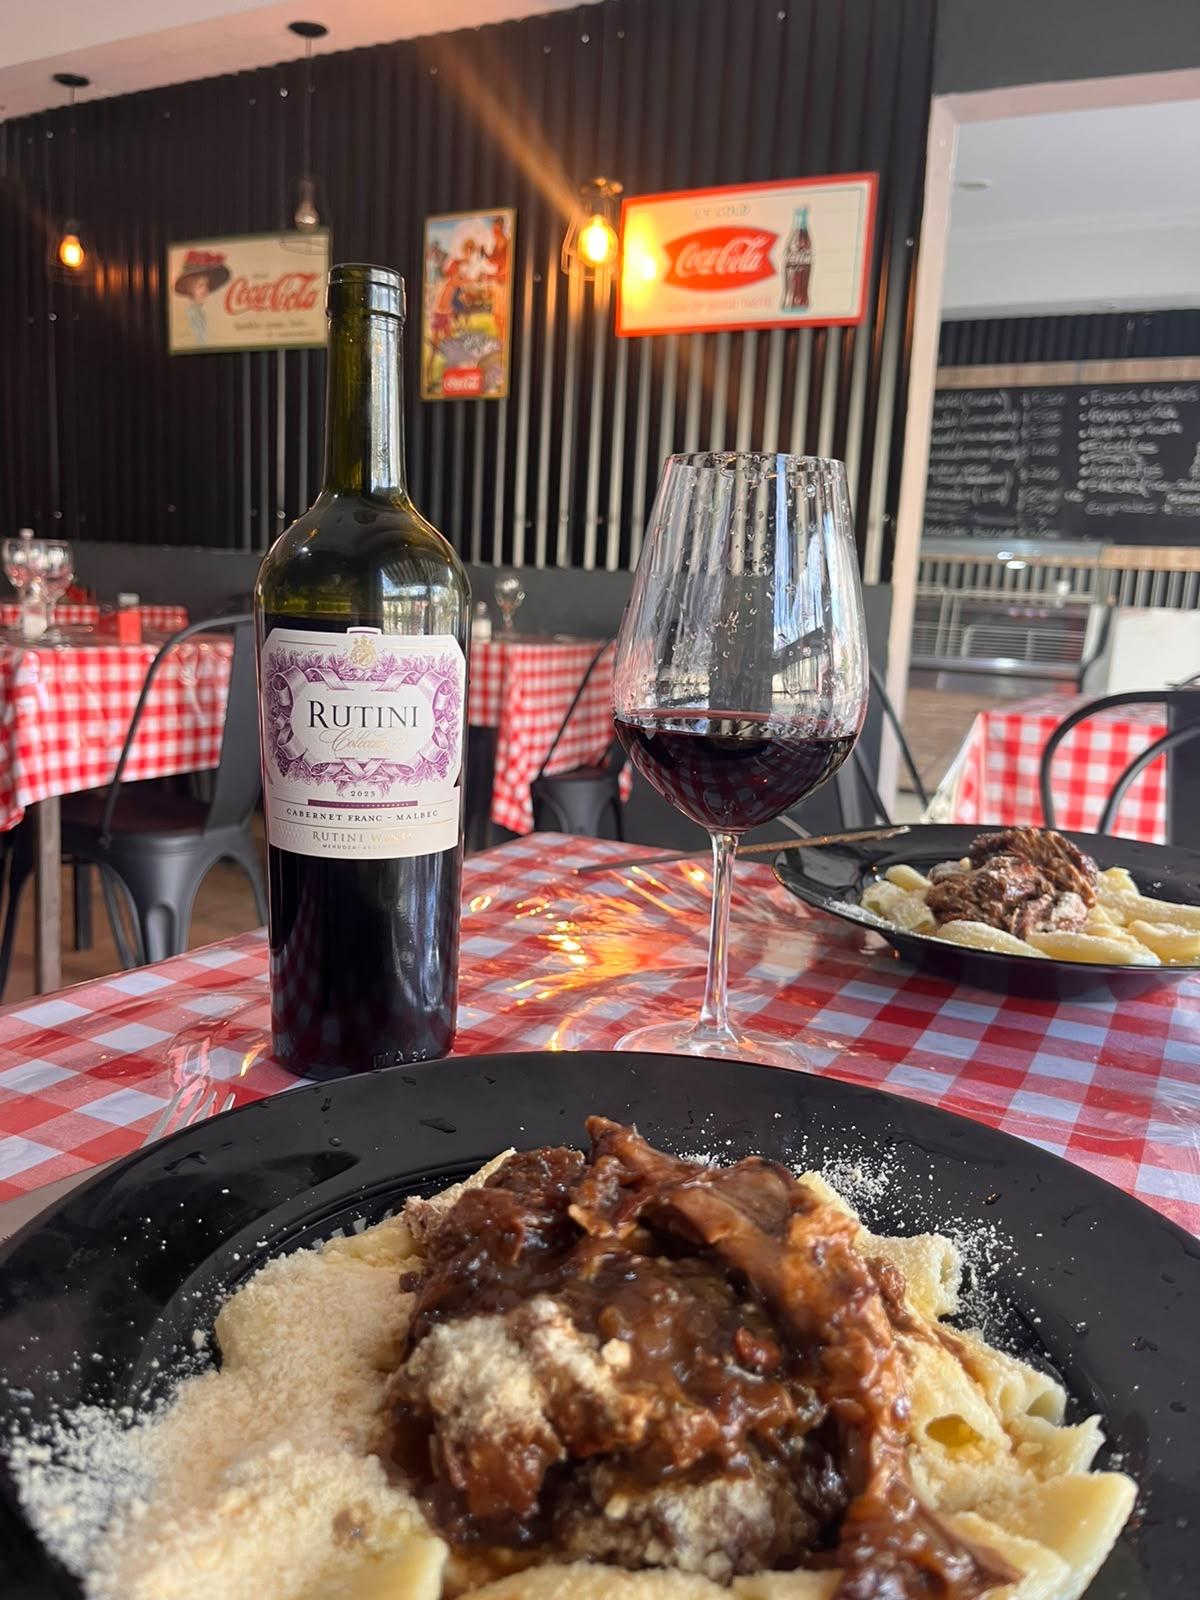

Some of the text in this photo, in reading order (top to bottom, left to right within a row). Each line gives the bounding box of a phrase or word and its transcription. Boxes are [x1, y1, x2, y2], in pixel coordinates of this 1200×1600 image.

[675, 235, 769, 278] Coca-Cola
[224, 272, 320, 316] Coca-Cola
[286, 807, 342, 821] CABERNET
[348, 815, 383, 823] FRANC
[396, 810, 438, 821] MALBEC
[312, 831, 417, 843] RUTINI WNES
